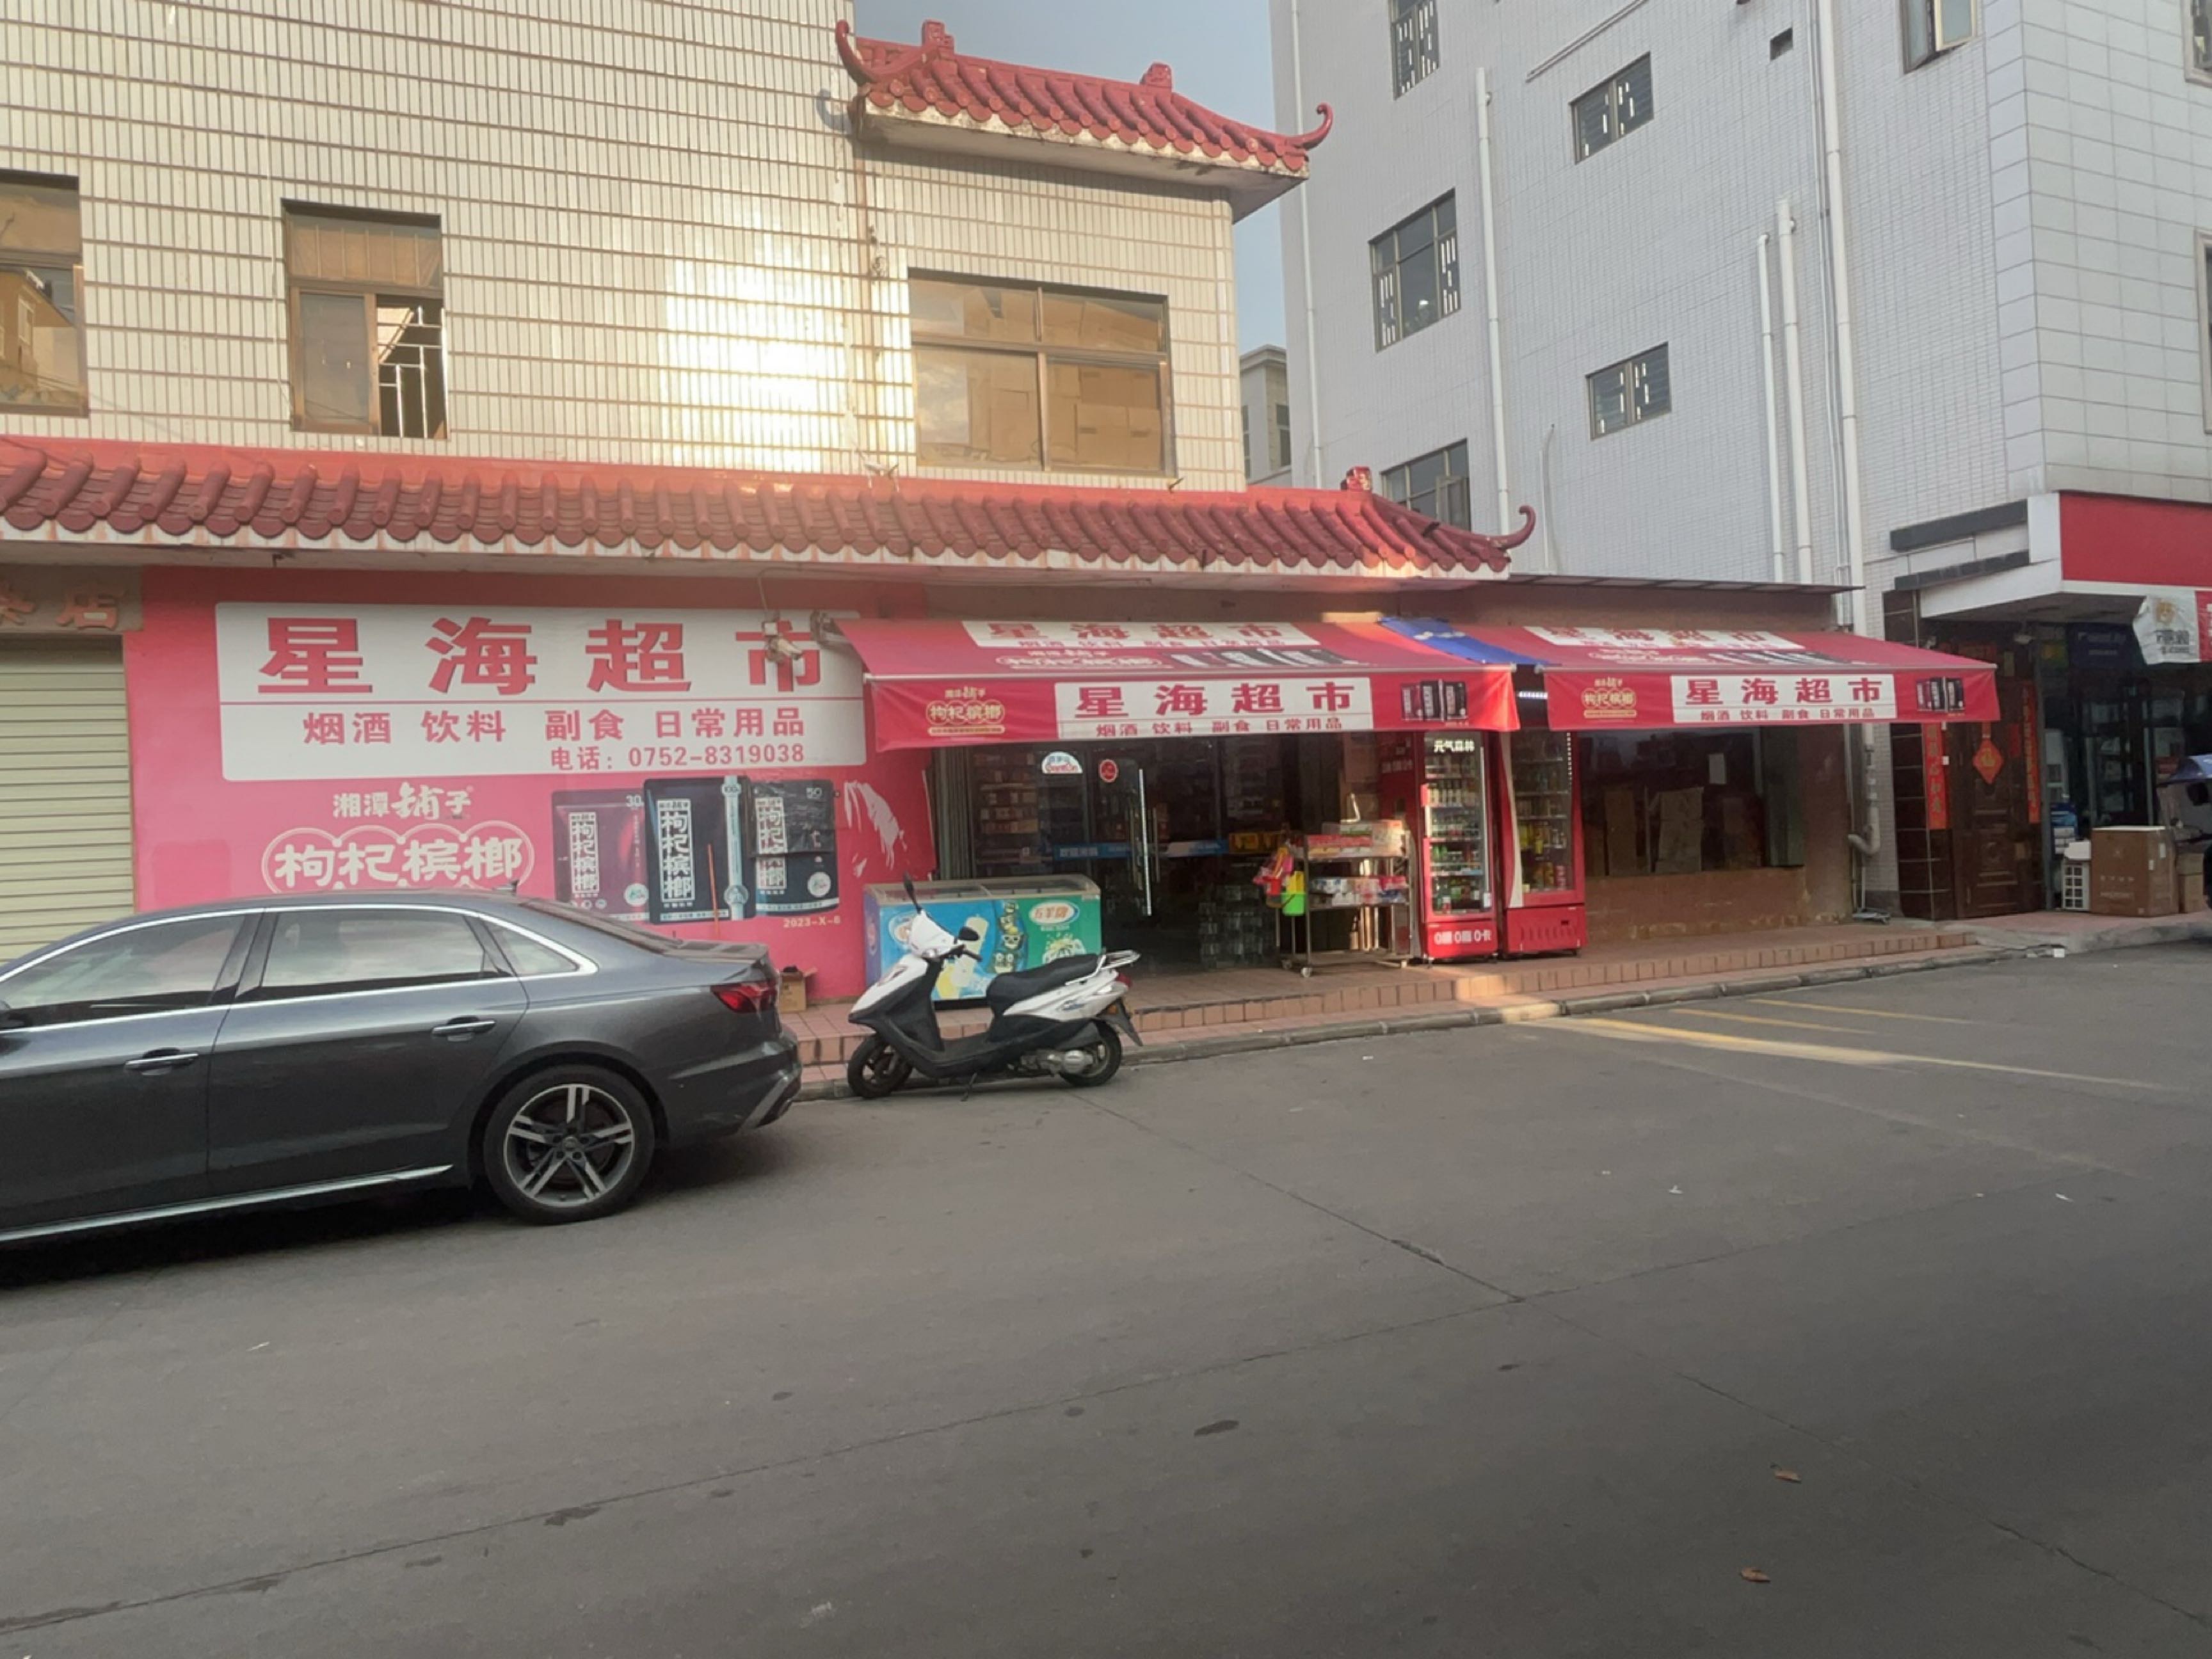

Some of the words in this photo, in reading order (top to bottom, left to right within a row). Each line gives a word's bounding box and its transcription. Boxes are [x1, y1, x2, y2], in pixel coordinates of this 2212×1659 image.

[257, 617, 822, 696] 星海超市
[1075, 681, 1355, 718] 星海超市
[1685, 677, 1882, 705] 星海超市
[303, 711, 391, 745] 烟酒
[421, 710, 506, 742] 饮料
[545, 709, 624, 742] 副食
[655, 707, 805, 739] 日常用品
[1096, 723, 1138, 737] 烟酒
[1152, 721, 1193, 735] 饮料
[1212, 719, 1251, 733] 副食
[1266, 717, 1342, 731] 日常用品
[1740, 709, 1769, 720] 饮料
[1820, 708, 1875, 719] 日常用品
[332, 781, 471, 821] 湘潭铺子
[274, 837, 522, 887] 枸杞槟榔
[661, 811, 692, 899] 枸杞槟榔
